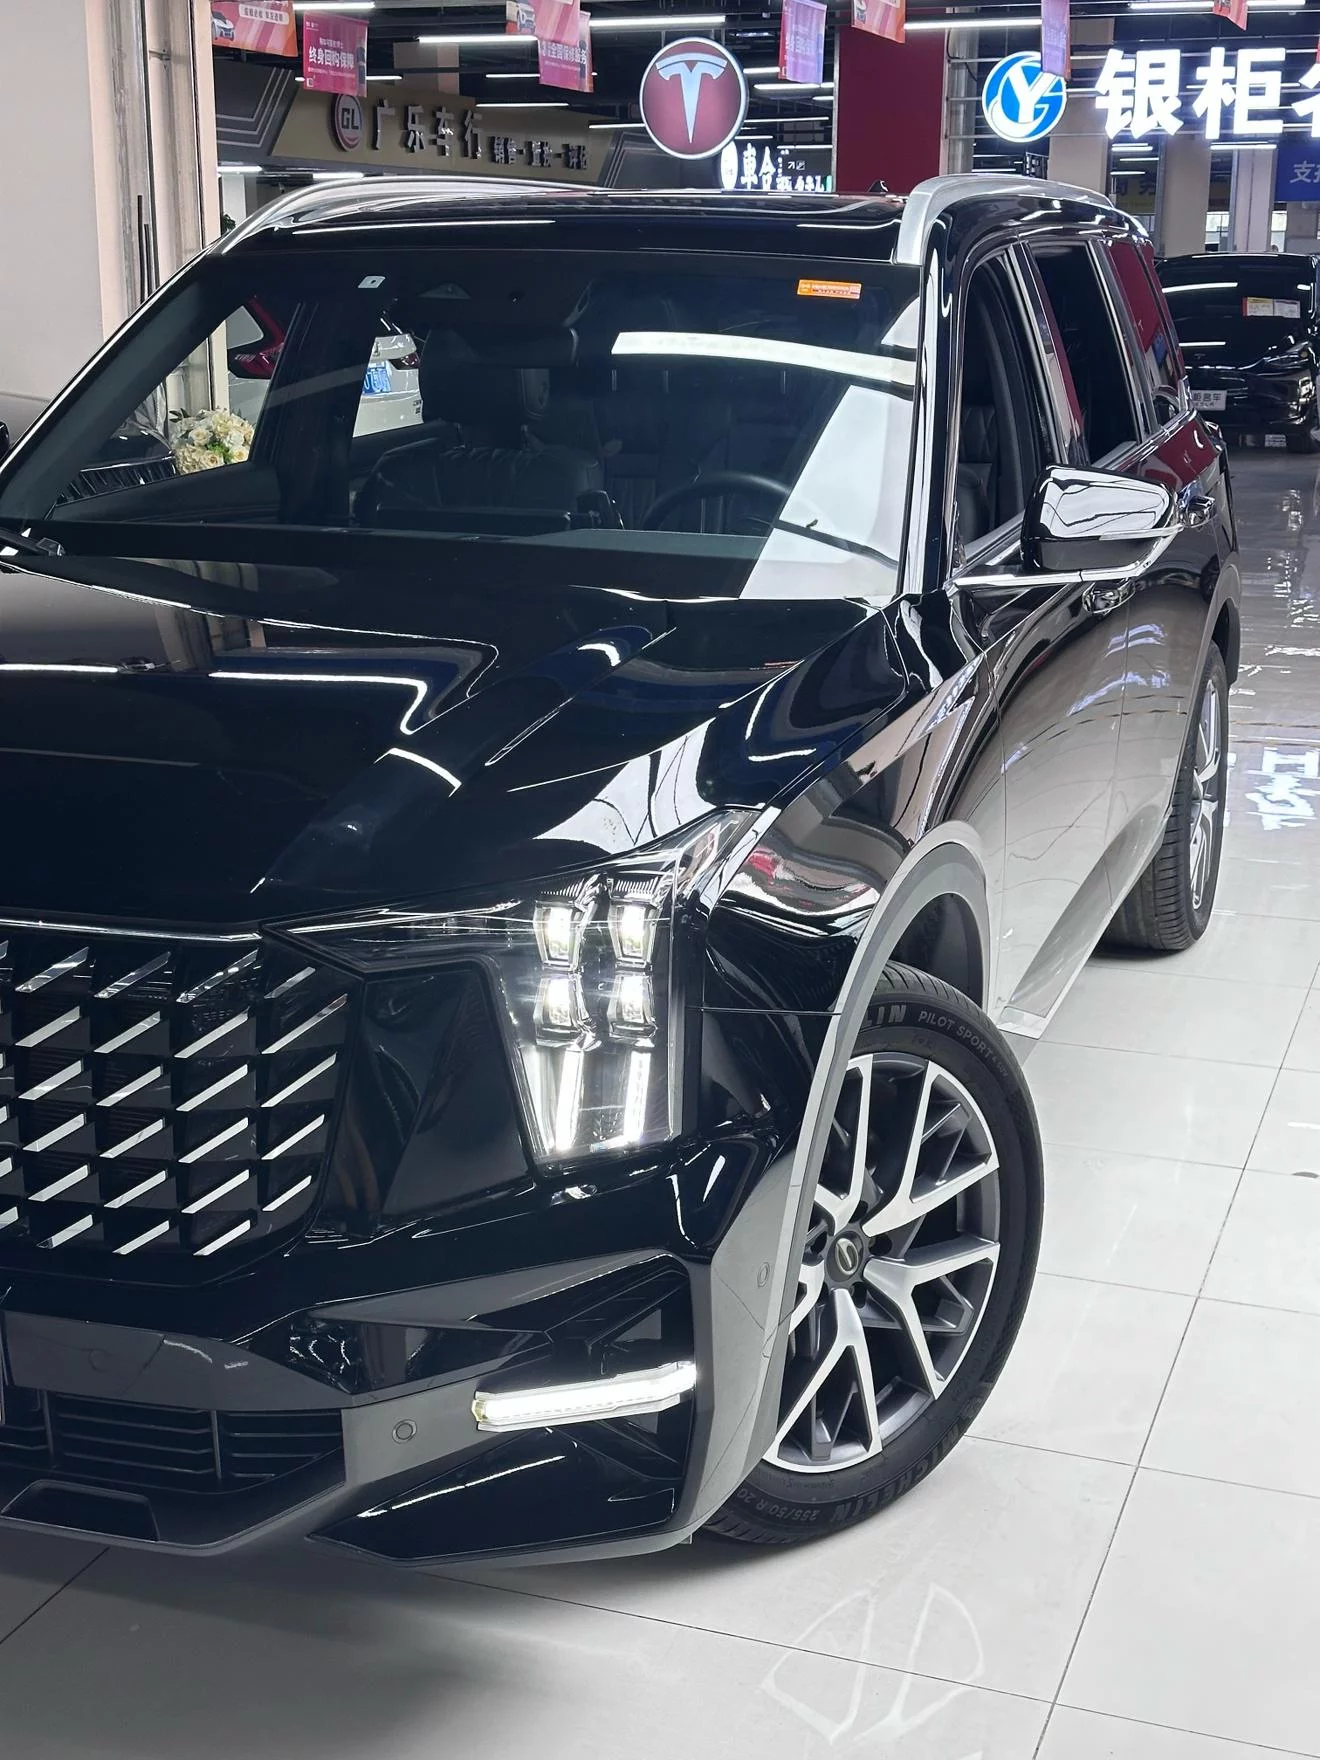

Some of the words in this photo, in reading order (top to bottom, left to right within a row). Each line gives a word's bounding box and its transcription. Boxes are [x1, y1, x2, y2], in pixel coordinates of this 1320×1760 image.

[374, 99, 485, 159] 广乐车行
[917, 1010, 956, 1029] PILOT
[956, 1026, 994, 1059] SPORT
